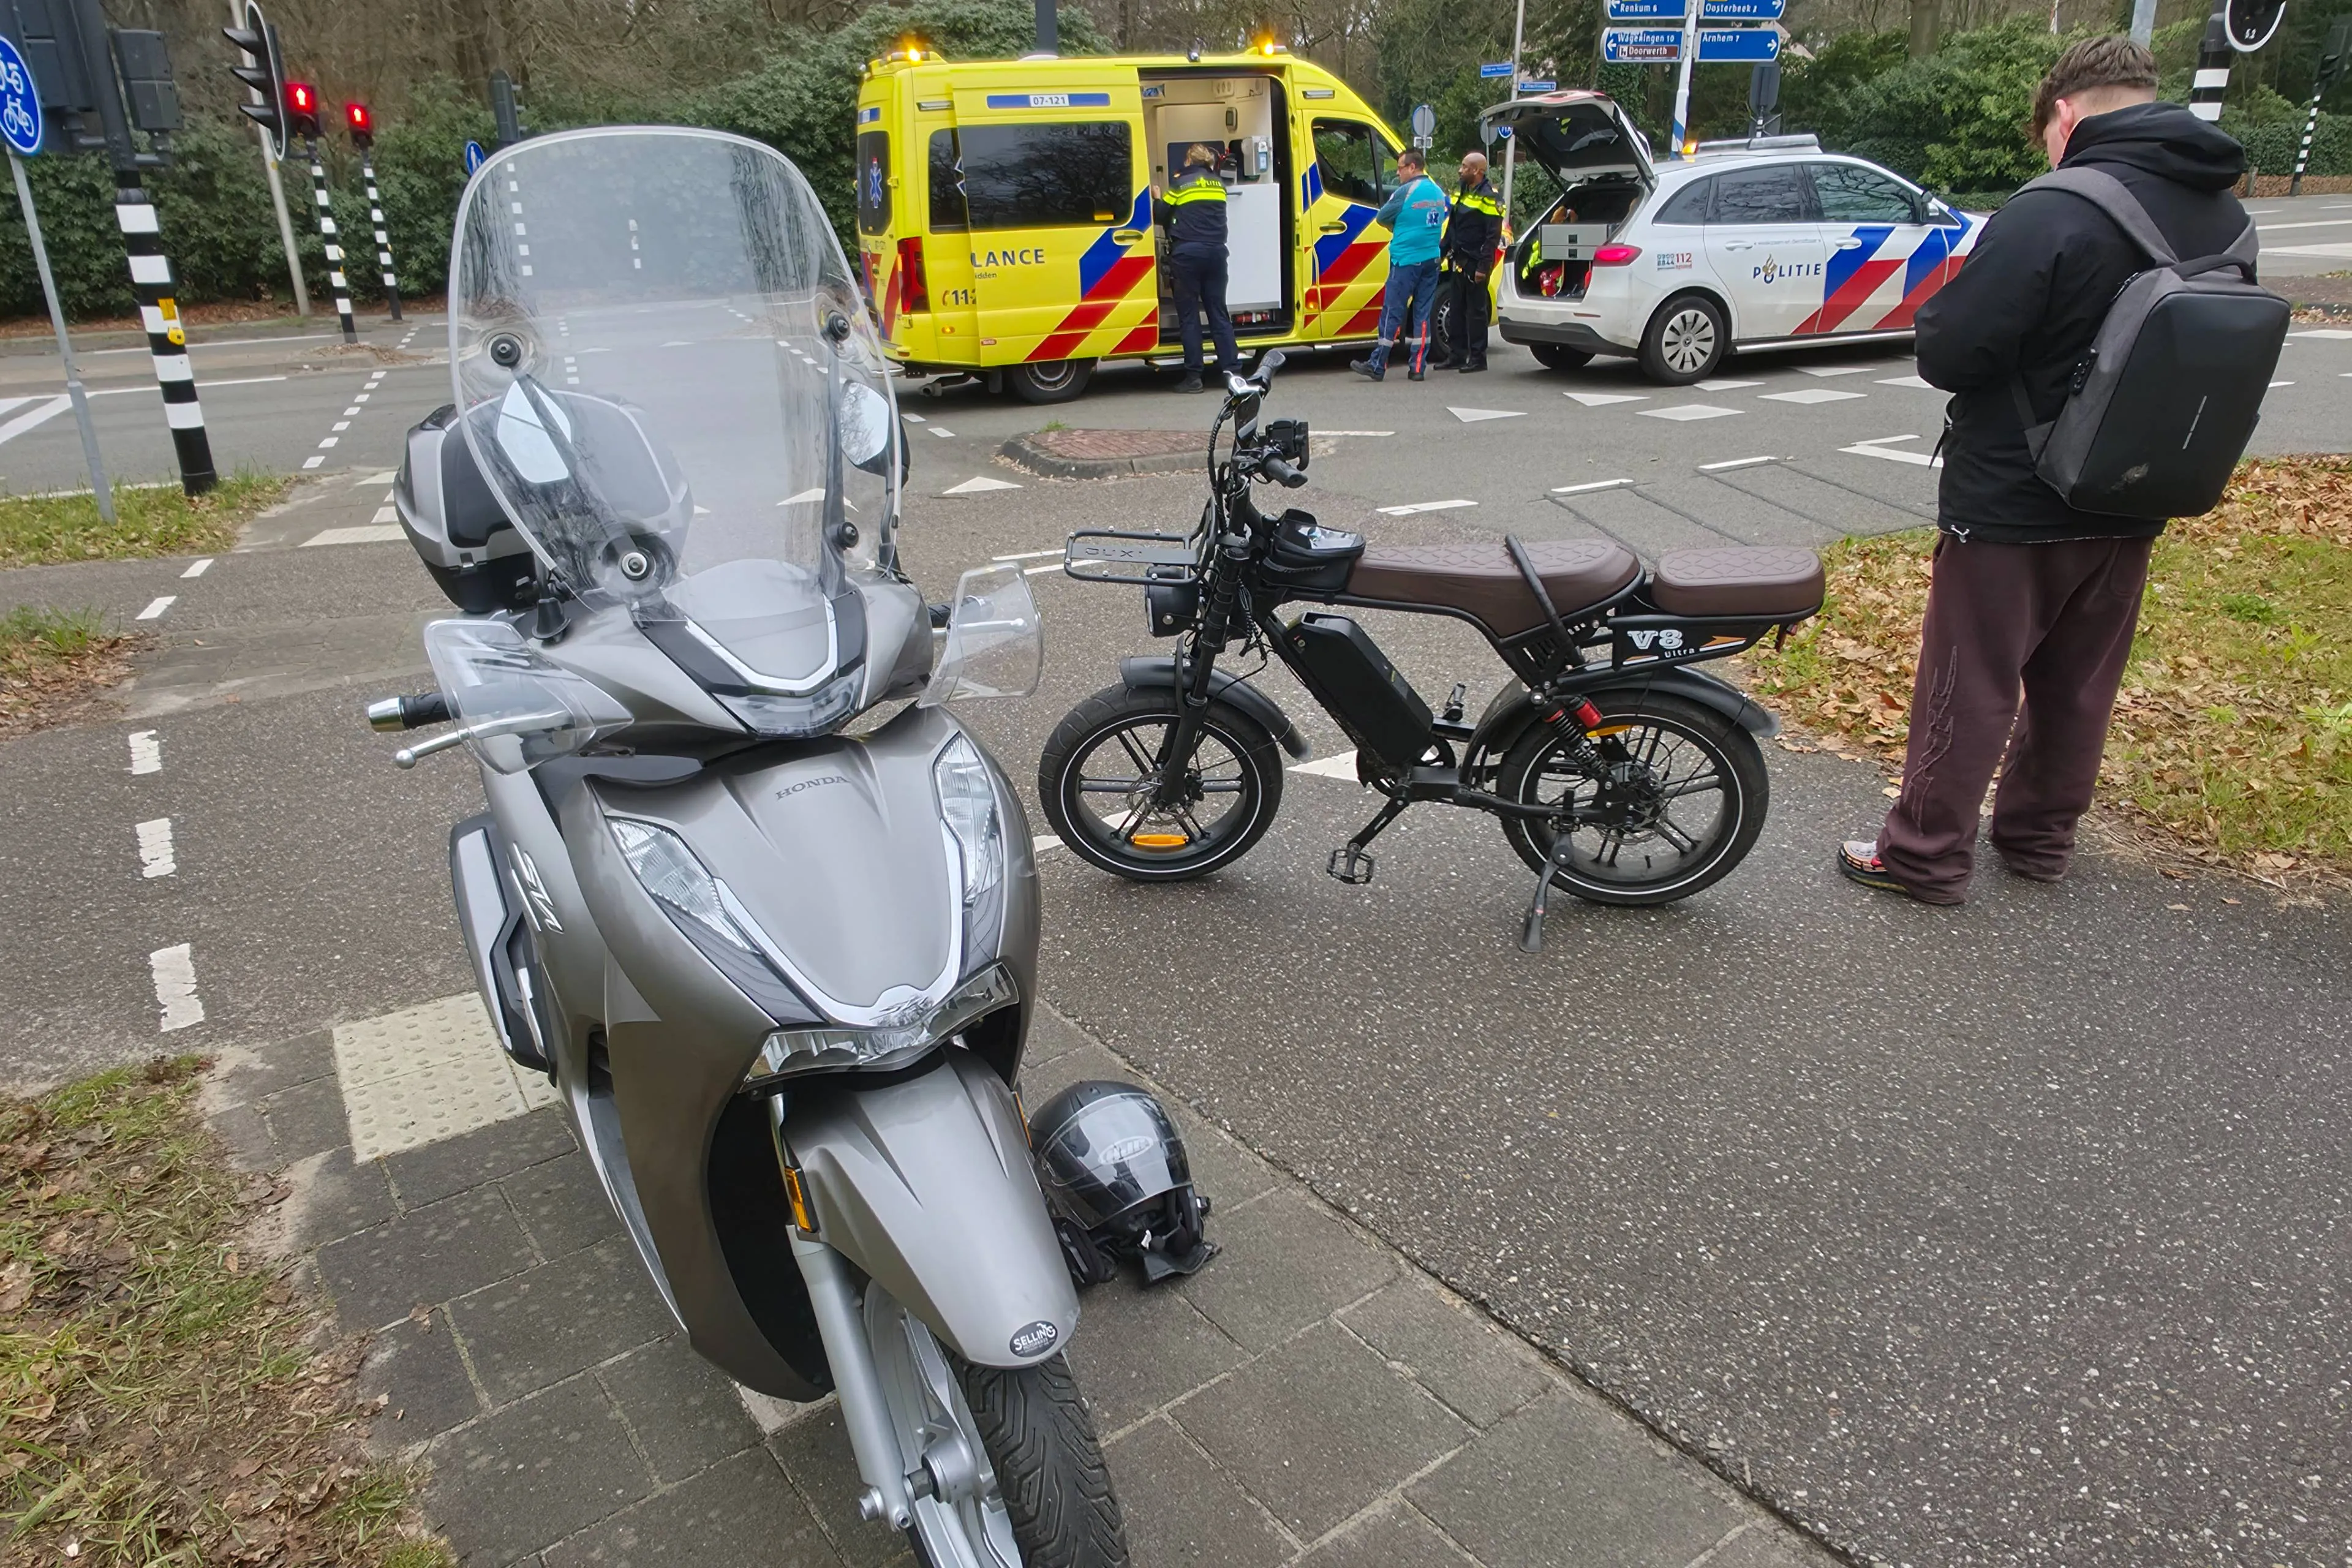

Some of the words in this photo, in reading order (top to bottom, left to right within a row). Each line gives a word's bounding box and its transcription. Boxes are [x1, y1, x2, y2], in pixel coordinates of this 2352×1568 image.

[1620, 4, 1651, 12] Renkum
[1705, 4, 1751, 13] Oosterbeek
[1702, 33, 1733, 42] Arnhem
[1629, 46, 1667, 55] Doorwerth
[1033, 96, 1066, 105] 07-121
[1676, 252, 1692, 263] 112
[1753, 263, 1822, 284] POLITIE
[1627, 629, 1683, 650] V8
[1664, 647, 1695, 658] Ultra
[775, 776, 851, 800] HONDA
[1014, 1325, 1056, 1351] SELLING
